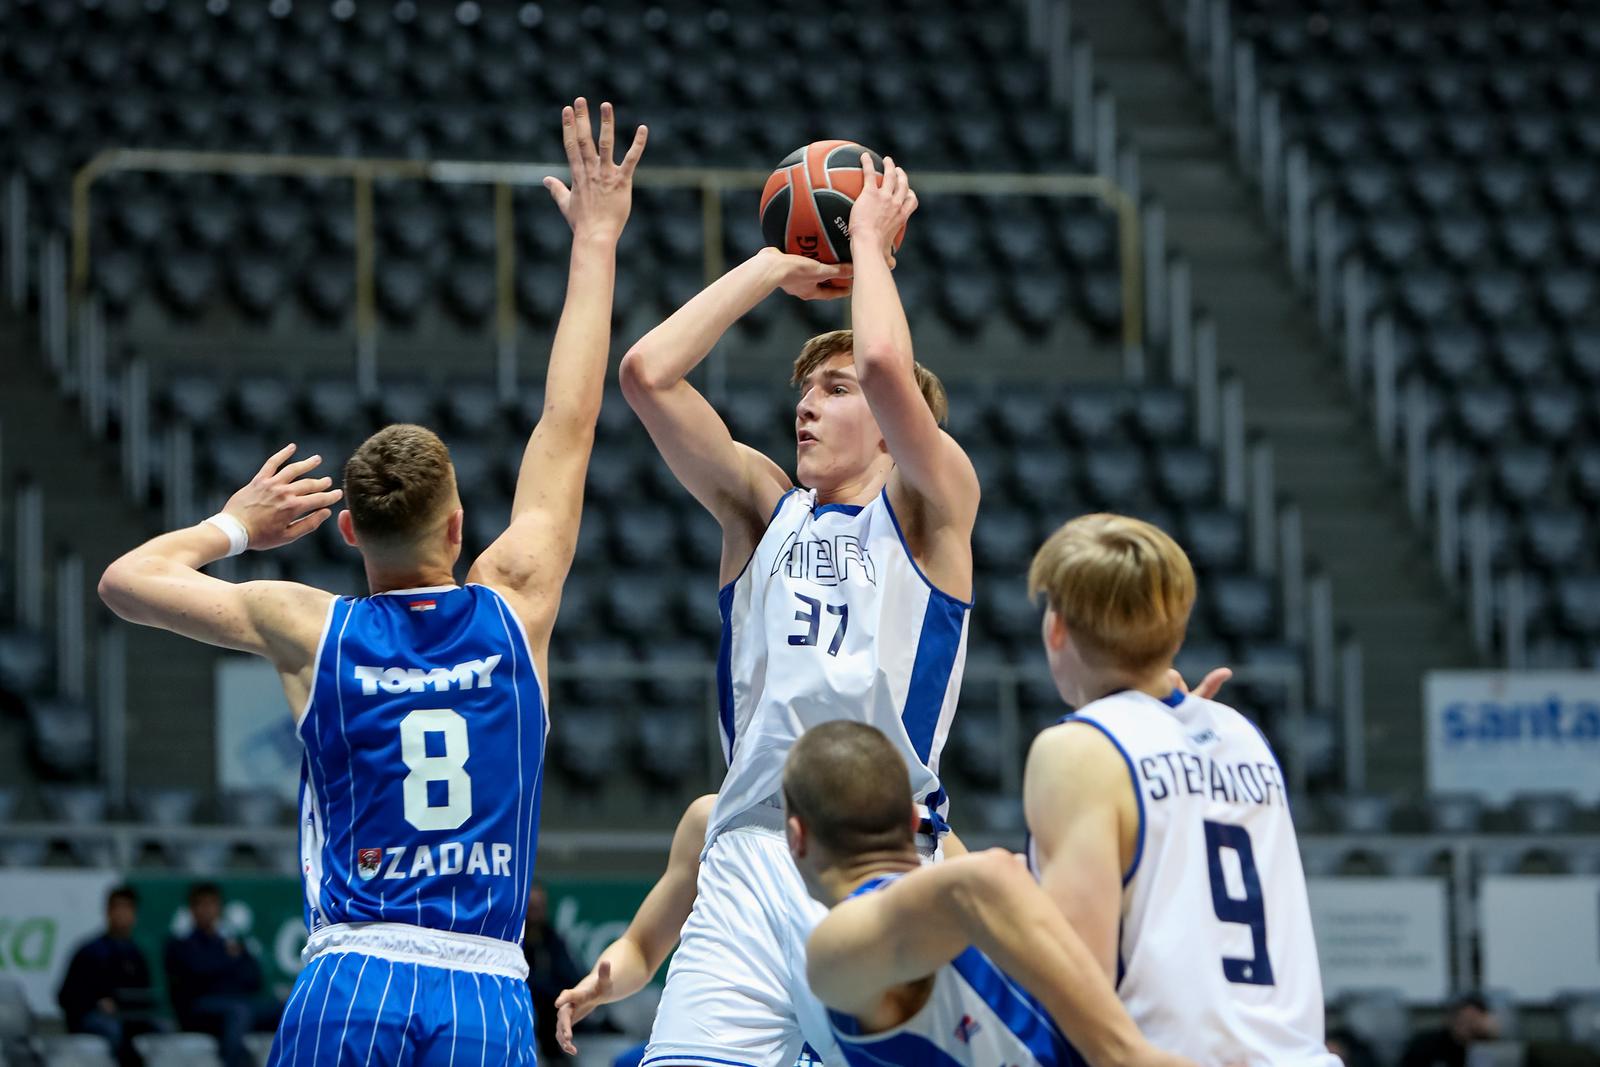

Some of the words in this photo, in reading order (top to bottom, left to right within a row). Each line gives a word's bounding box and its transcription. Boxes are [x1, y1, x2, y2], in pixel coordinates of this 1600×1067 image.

[787, 592, 849, 657] 37
[353, 654, 503, 696] TOMMY
[400, 708, 473, 832] 8
[382, 841, 513, 881] ZADAR
[1203, 819, 1276, 986] 9
